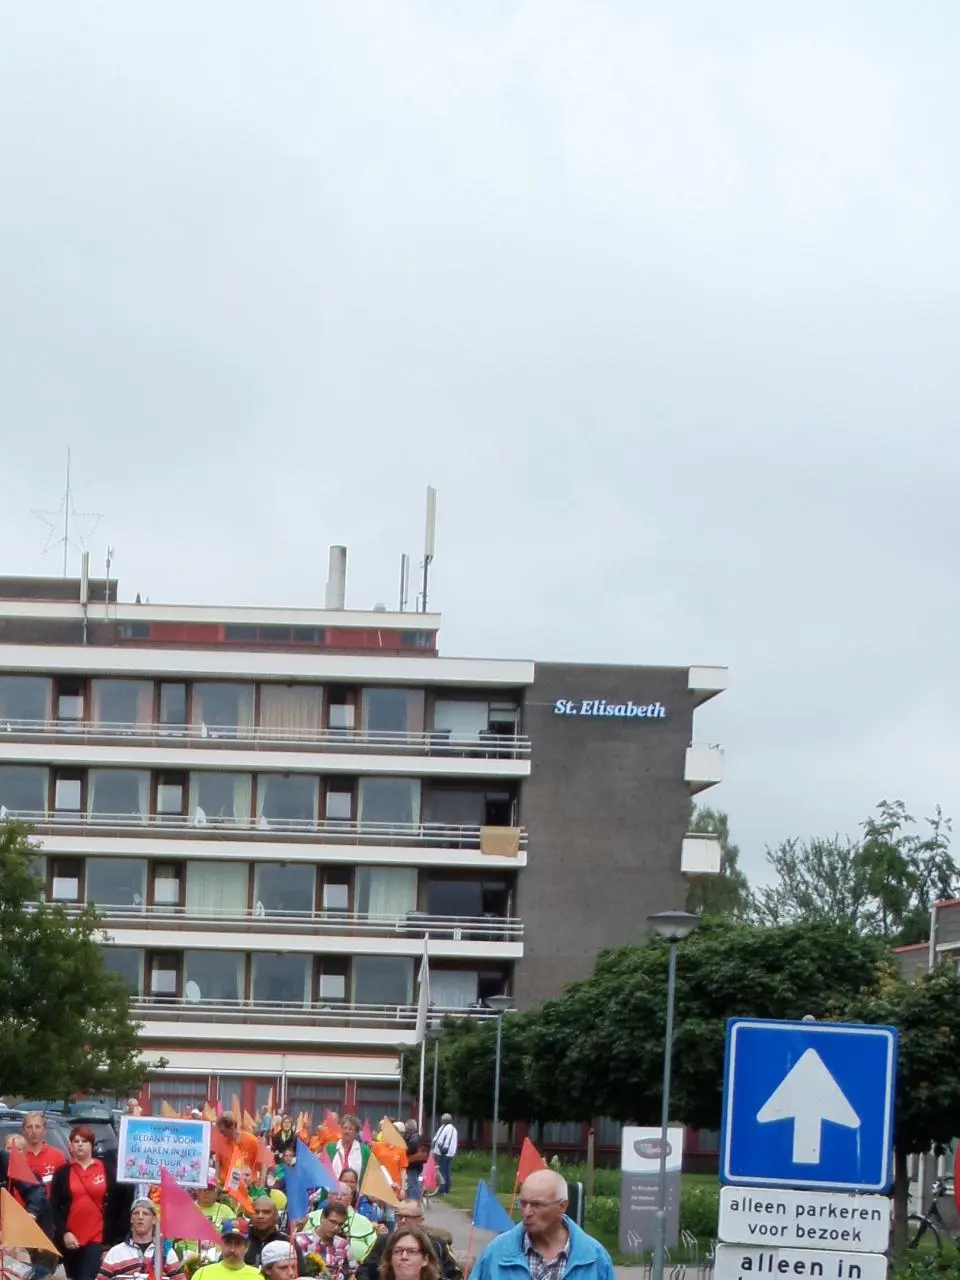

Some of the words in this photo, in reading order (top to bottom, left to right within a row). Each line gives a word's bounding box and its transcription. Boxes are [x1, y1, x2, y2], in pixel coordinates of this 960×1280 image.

[554, 699, 577, 714] St.
[580, 699, 666, 717] Elisabeth
[730, 1196, 786, 1214] alleen
[795, 1203, 881, 1221] parkeren
[748, 1223, 788, 1237] voor
[796, 1224, 862, 1242] bezoek
[741, 1253, 823, 1276] alleen
[838, 1259, 862, 1279] in
